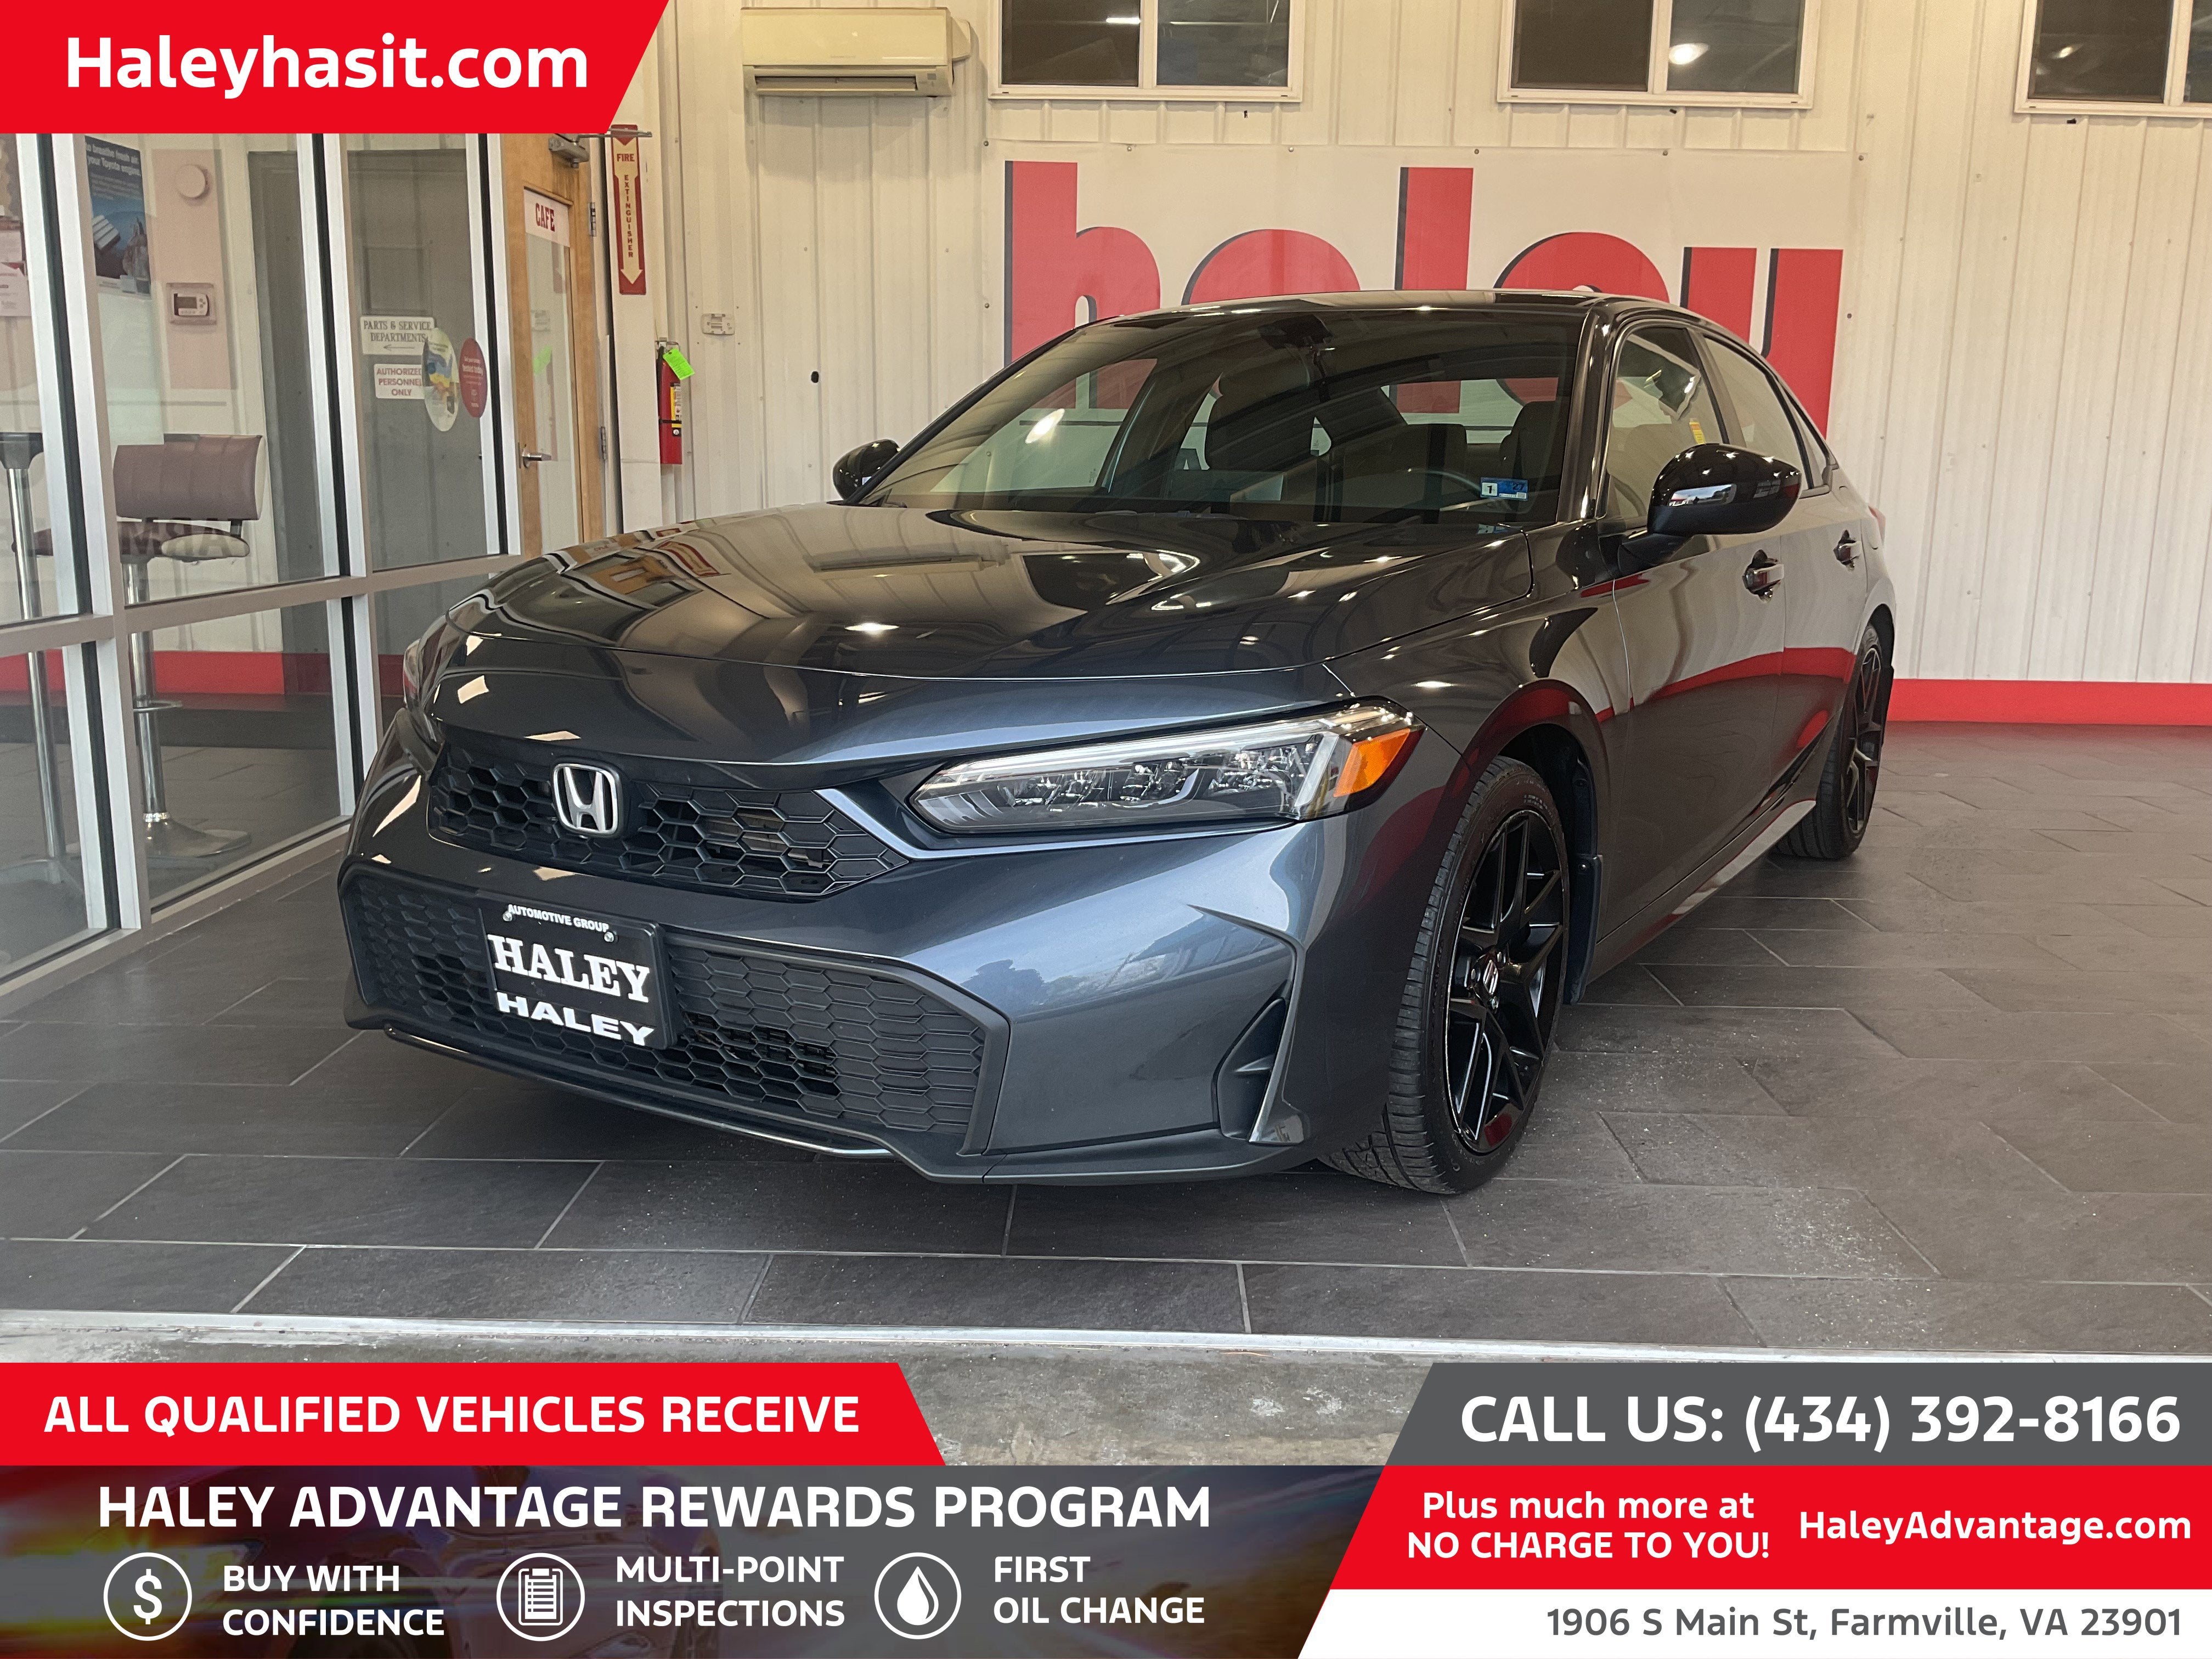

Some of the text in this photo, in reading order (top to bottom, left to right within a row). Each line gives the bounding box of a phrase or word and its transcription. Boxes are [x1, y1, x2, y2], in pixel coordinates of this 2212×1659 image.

[616, 154, 635, 162] FIRE
[535, 202, 555, 232] CAFE
[624, 174, 633, 258] EXTINGUISHER
[1005, 160, 1844, 439] hly
[364, 320, 388, 330] PARTS
[399, 321, 432, 331] SERVICE
[370, 332, 426, 342] DEPARTMENTS
[1487, 486, 1493, 494] 1
[508, 904, 610, 933] AUTOMOTIVE GROUP
[487, 934, 650, 1003] HALEY
[496, 991, 654, 1046] HALEY
